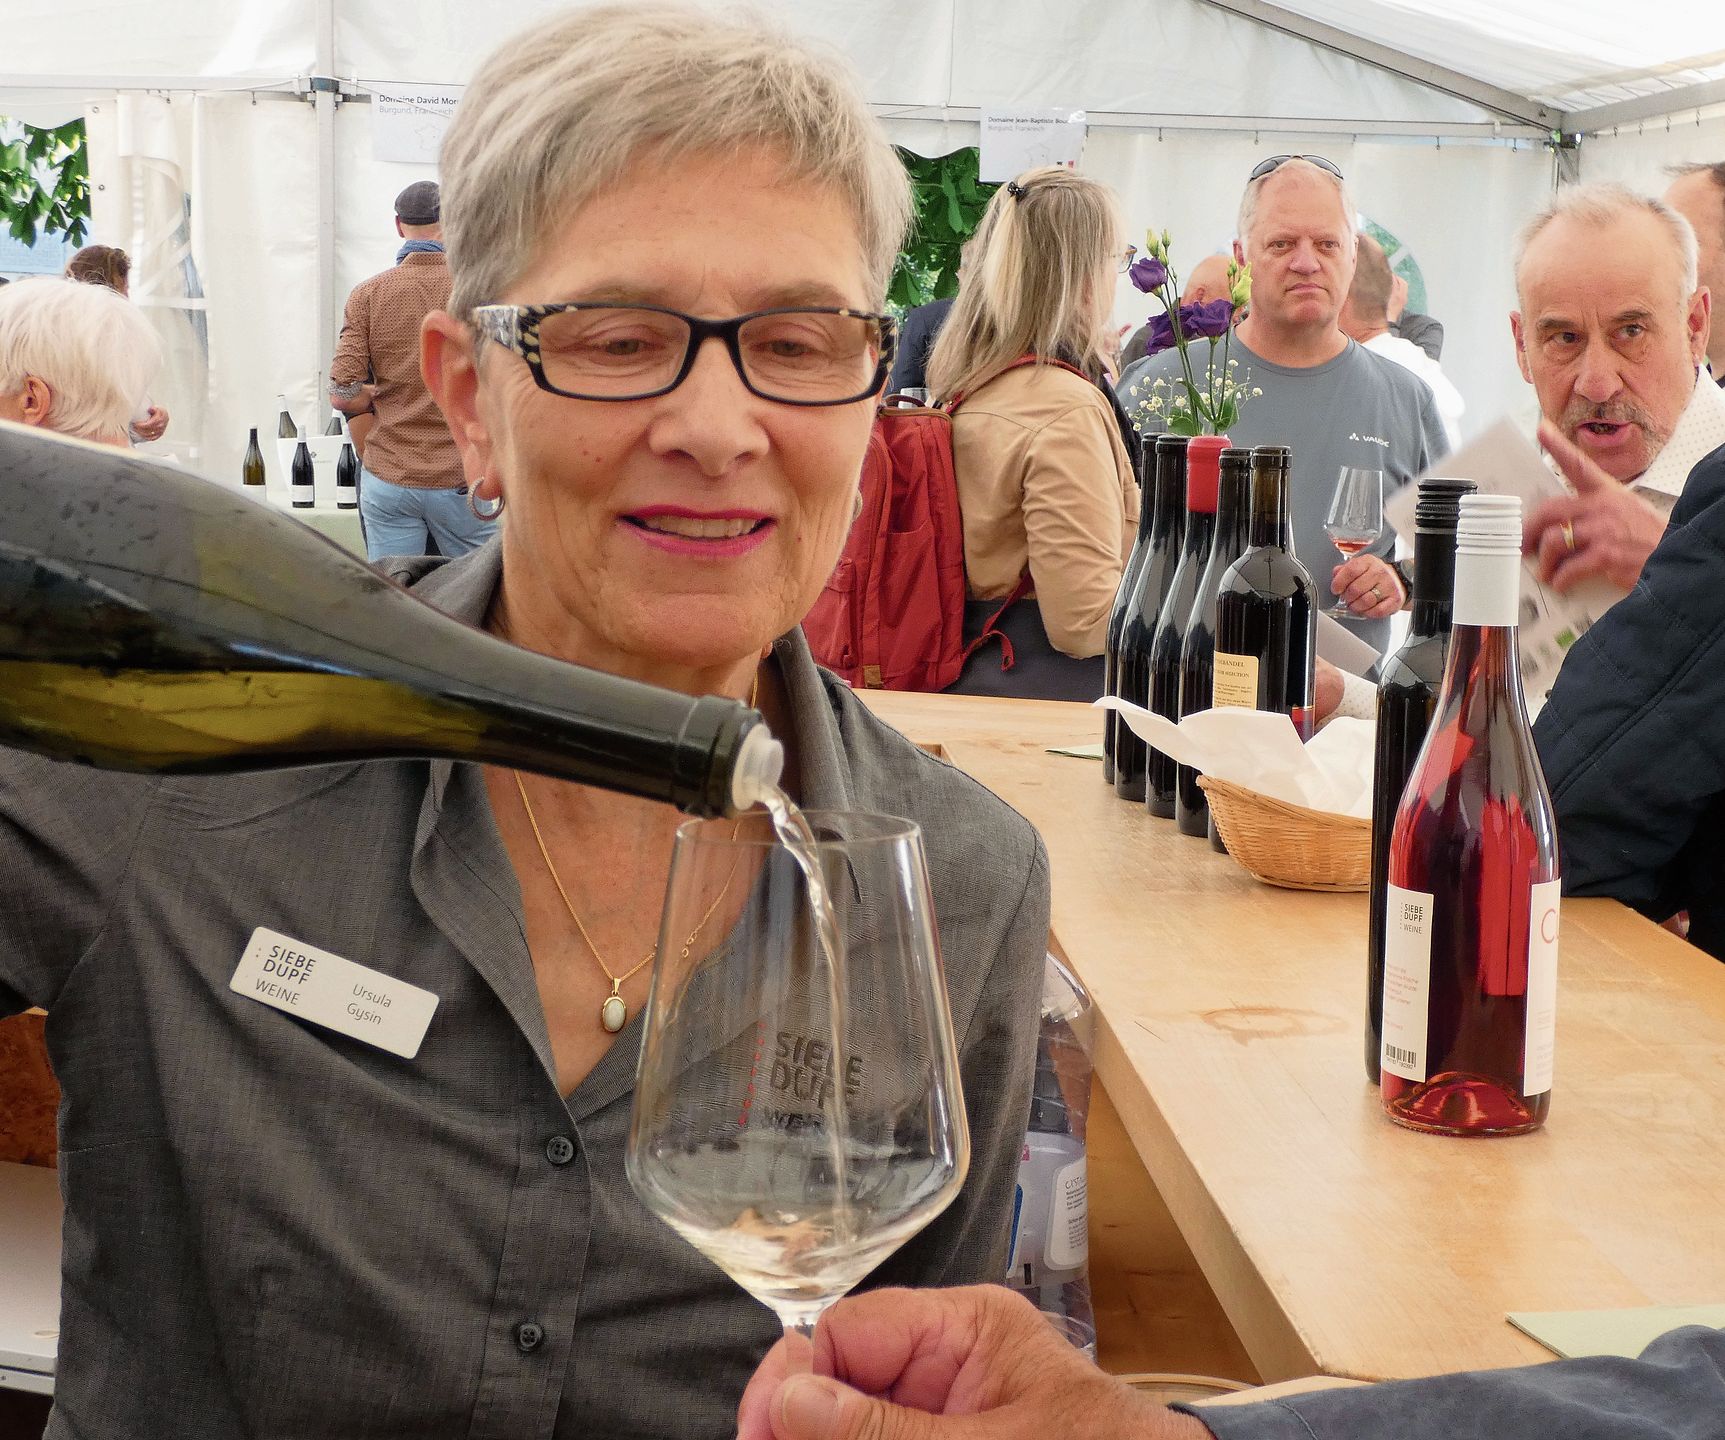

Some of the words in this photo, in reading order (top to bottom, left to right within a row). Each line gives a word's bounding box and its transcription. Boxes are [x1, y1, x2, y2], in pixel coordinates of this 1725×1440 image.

[416, 96, 440, 105] David
[1404, 903, 1424, 915] SIEBE
[1404, 911, 1423, 923] DUPF
[1403, 923, 1423, 935] WEINE
[269, 945, 317, 973] SIEBE
[263, 959, 310, 985] DUPF
[255, 978, 301, 1006] WEINE
[352, 983, 392, 1008] Ursula
[346, 1002, 382, 1025] Gysin
